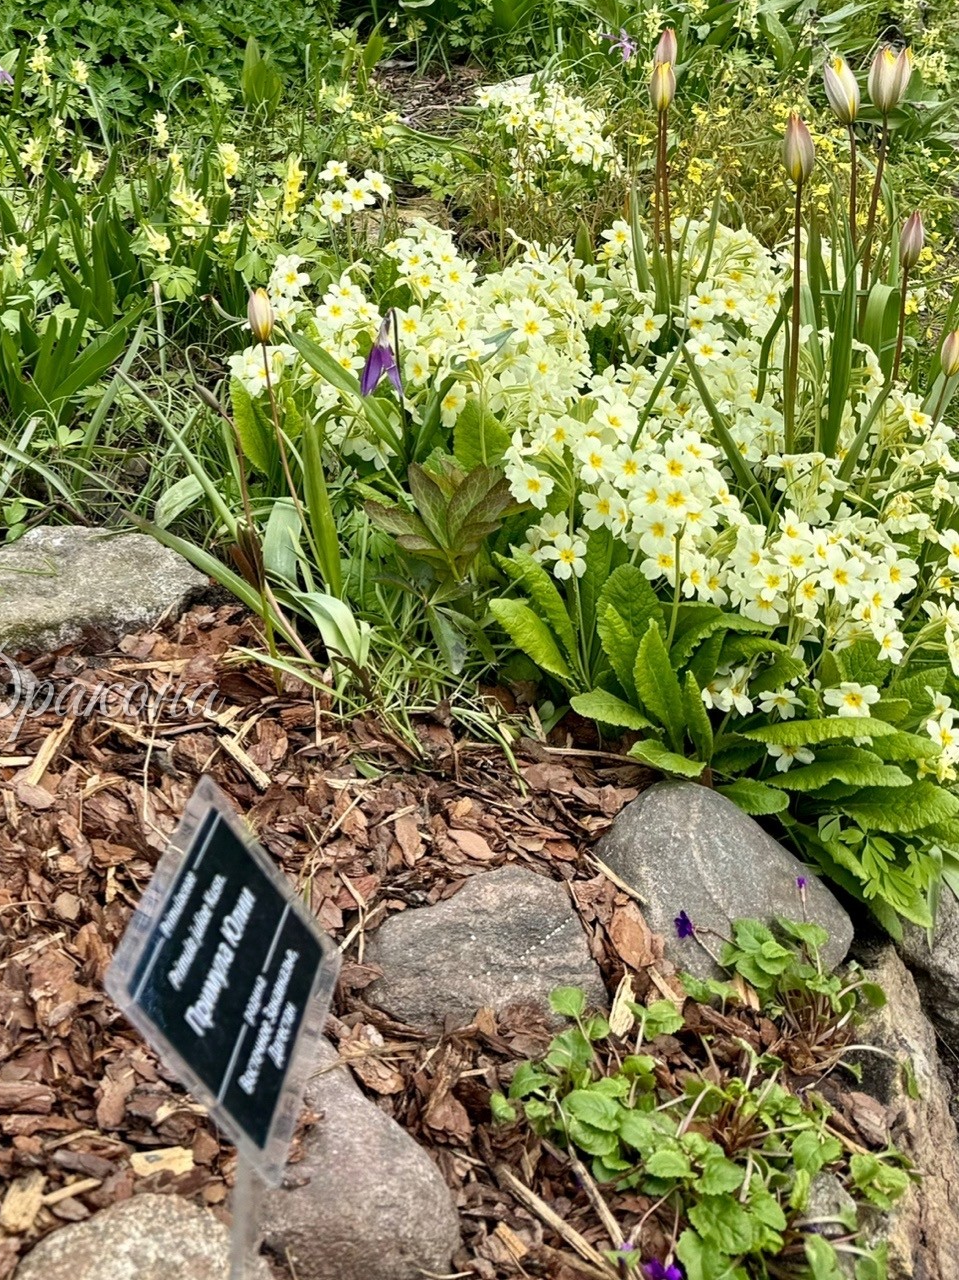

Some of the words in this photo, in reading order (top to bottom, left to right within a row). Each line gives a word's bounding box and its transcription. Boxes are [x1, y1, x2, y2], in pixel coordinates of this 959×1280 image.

[159, 870, 196, 937] Primulaceae
[168, 936, 199, 989] Primula
[184, 942, 234, 1036] Примула
[220, 886, 255, 947] Юлии
[243, 975, 266, 1025] родина
[238, 1019, 273, 1094] Восточное
[267, 1001, 296, 1068] Дагестан
